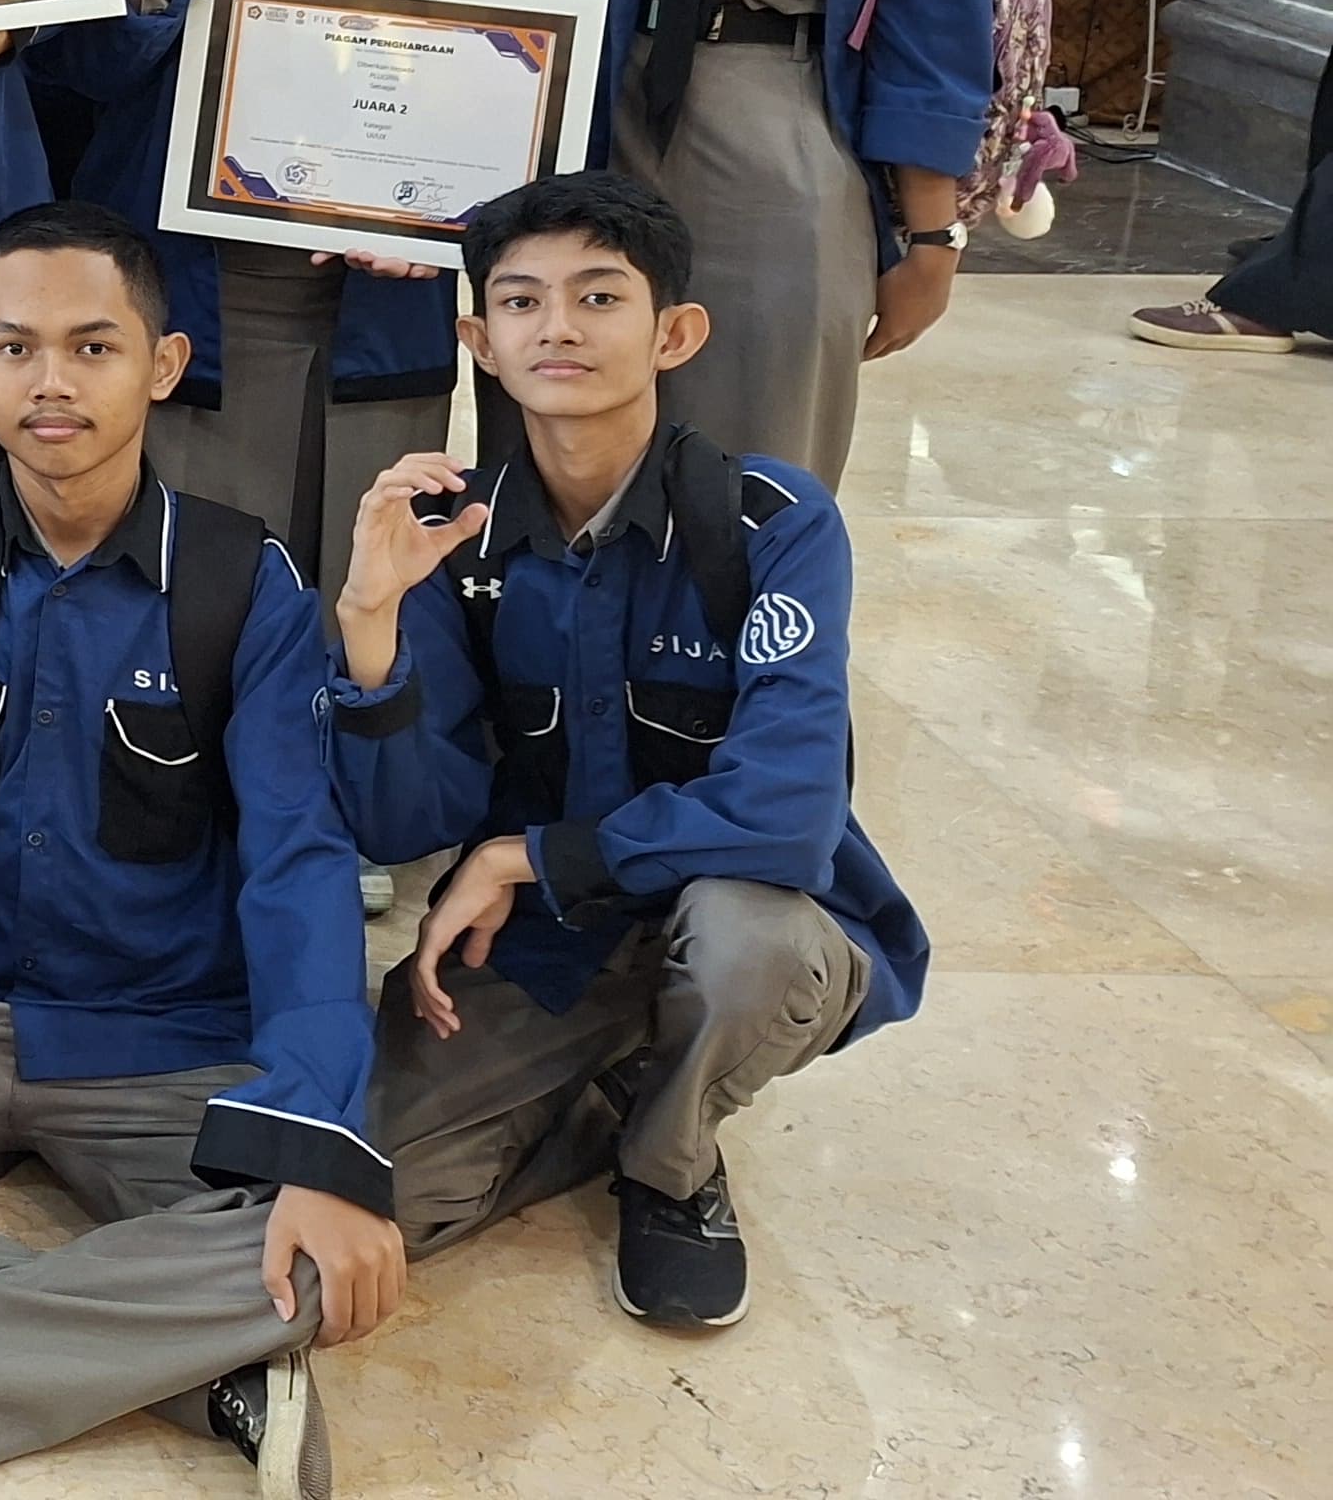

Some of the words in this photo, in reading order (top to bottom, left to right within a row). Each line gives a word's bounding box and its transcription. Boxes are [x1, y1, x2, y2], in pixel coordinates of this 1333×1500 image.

[325, 33, 368, 46] PIAGAM
[370, 37, 455, 55] PENGHARGAAN
[352, 98, 396, 114] JUARA
[399, 104, 408, 115] 2
[650, 634, 728, 662] SIJA
